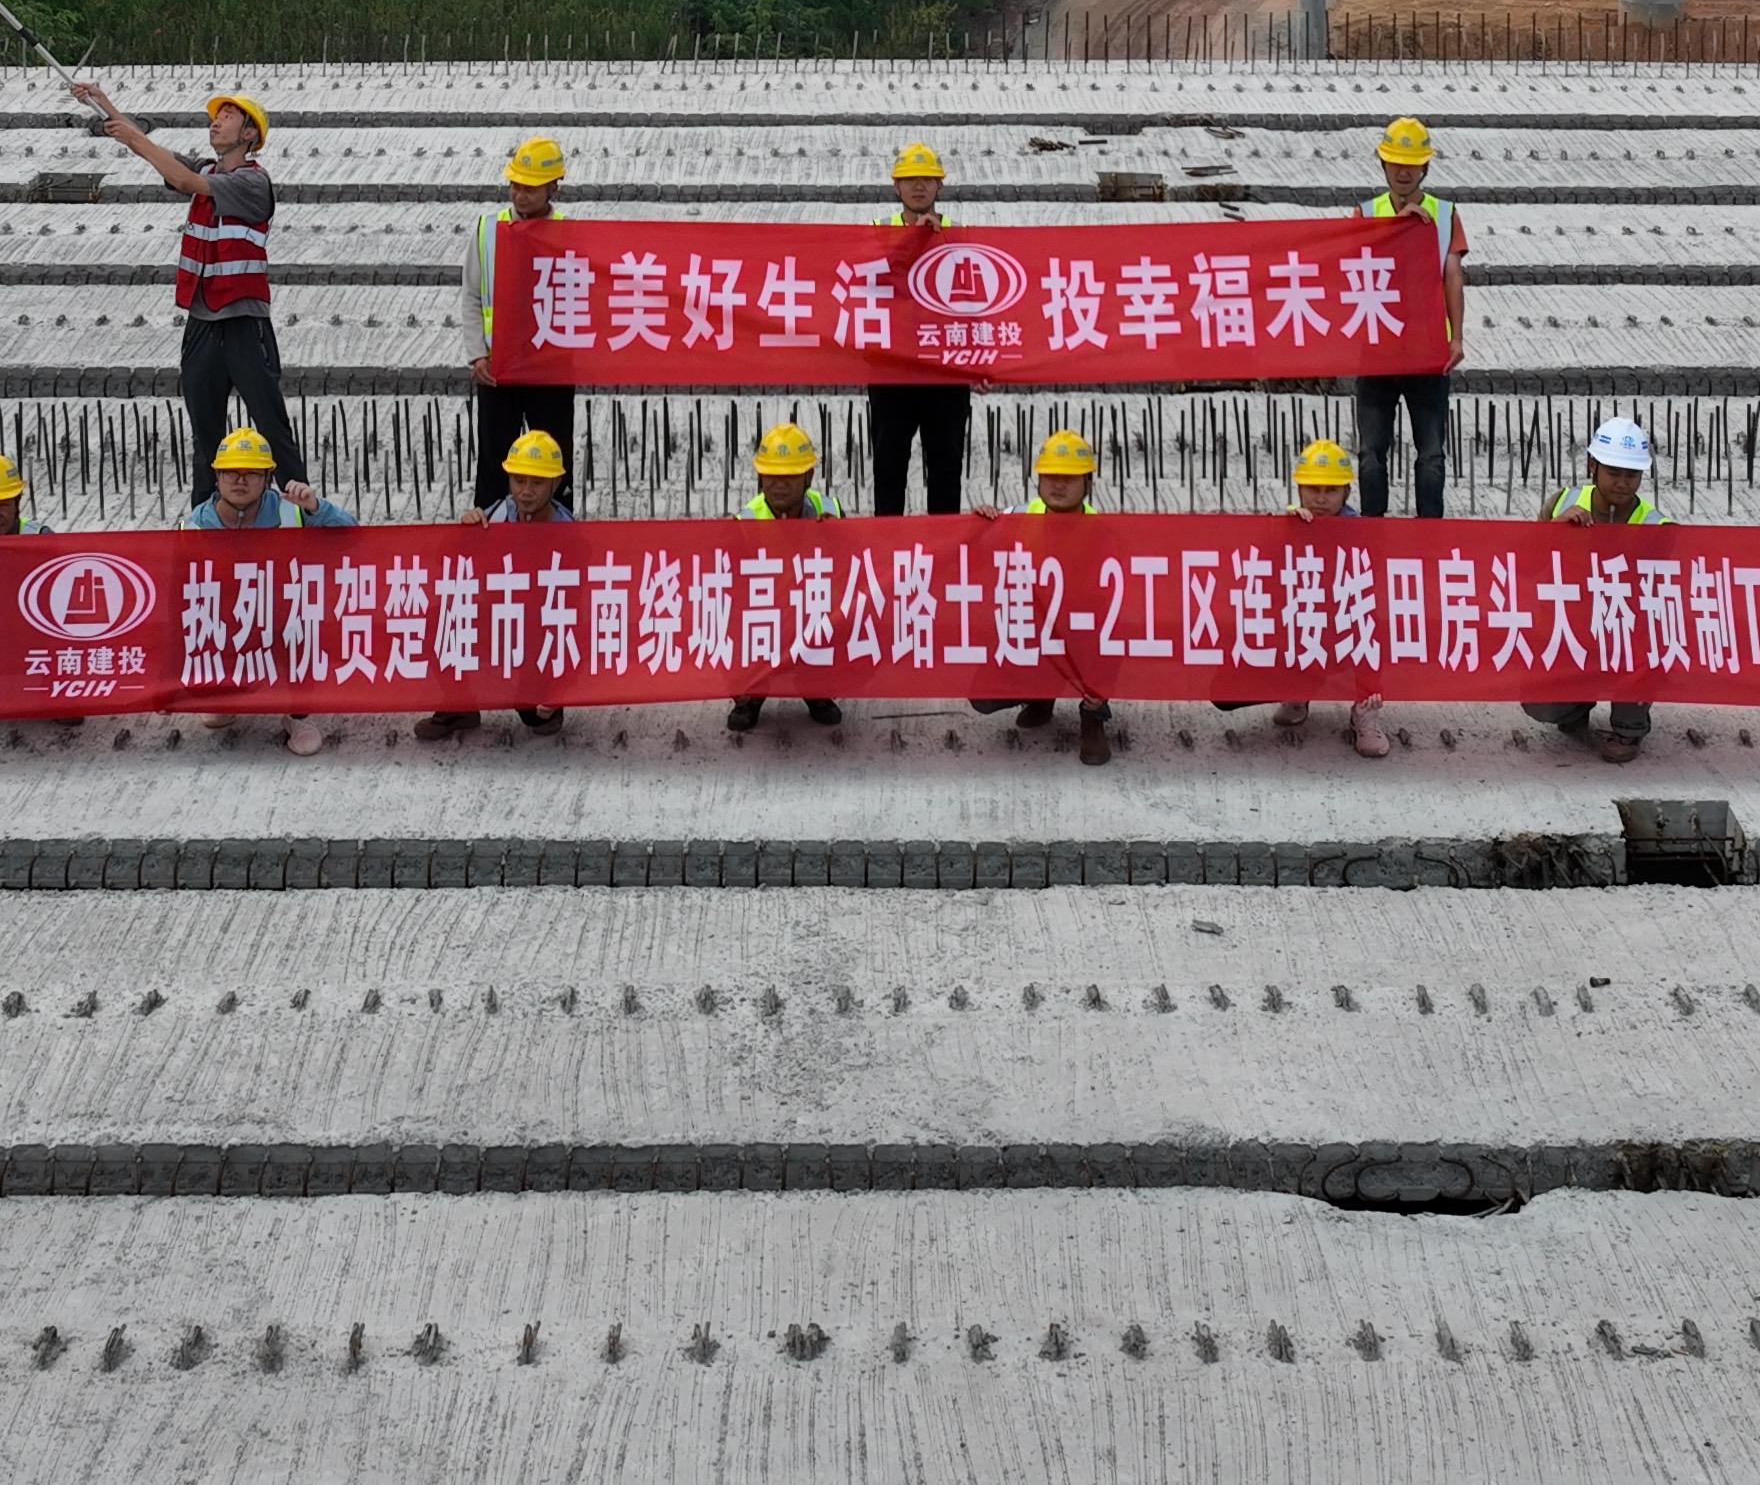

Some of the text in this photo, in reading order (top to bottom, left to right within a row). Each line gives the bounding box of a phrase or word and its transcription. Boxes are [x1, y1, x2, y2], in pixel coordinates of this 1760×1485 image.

[531, 247, 1405, 351] 建美好生活 投幸福未来
[916, 321, 1023, 347] 云南建投
[942, 349, 999, 365] YCIH
[24, 645, 147, 676] 云南建投
[50, 679, 117, 698] YCIH
